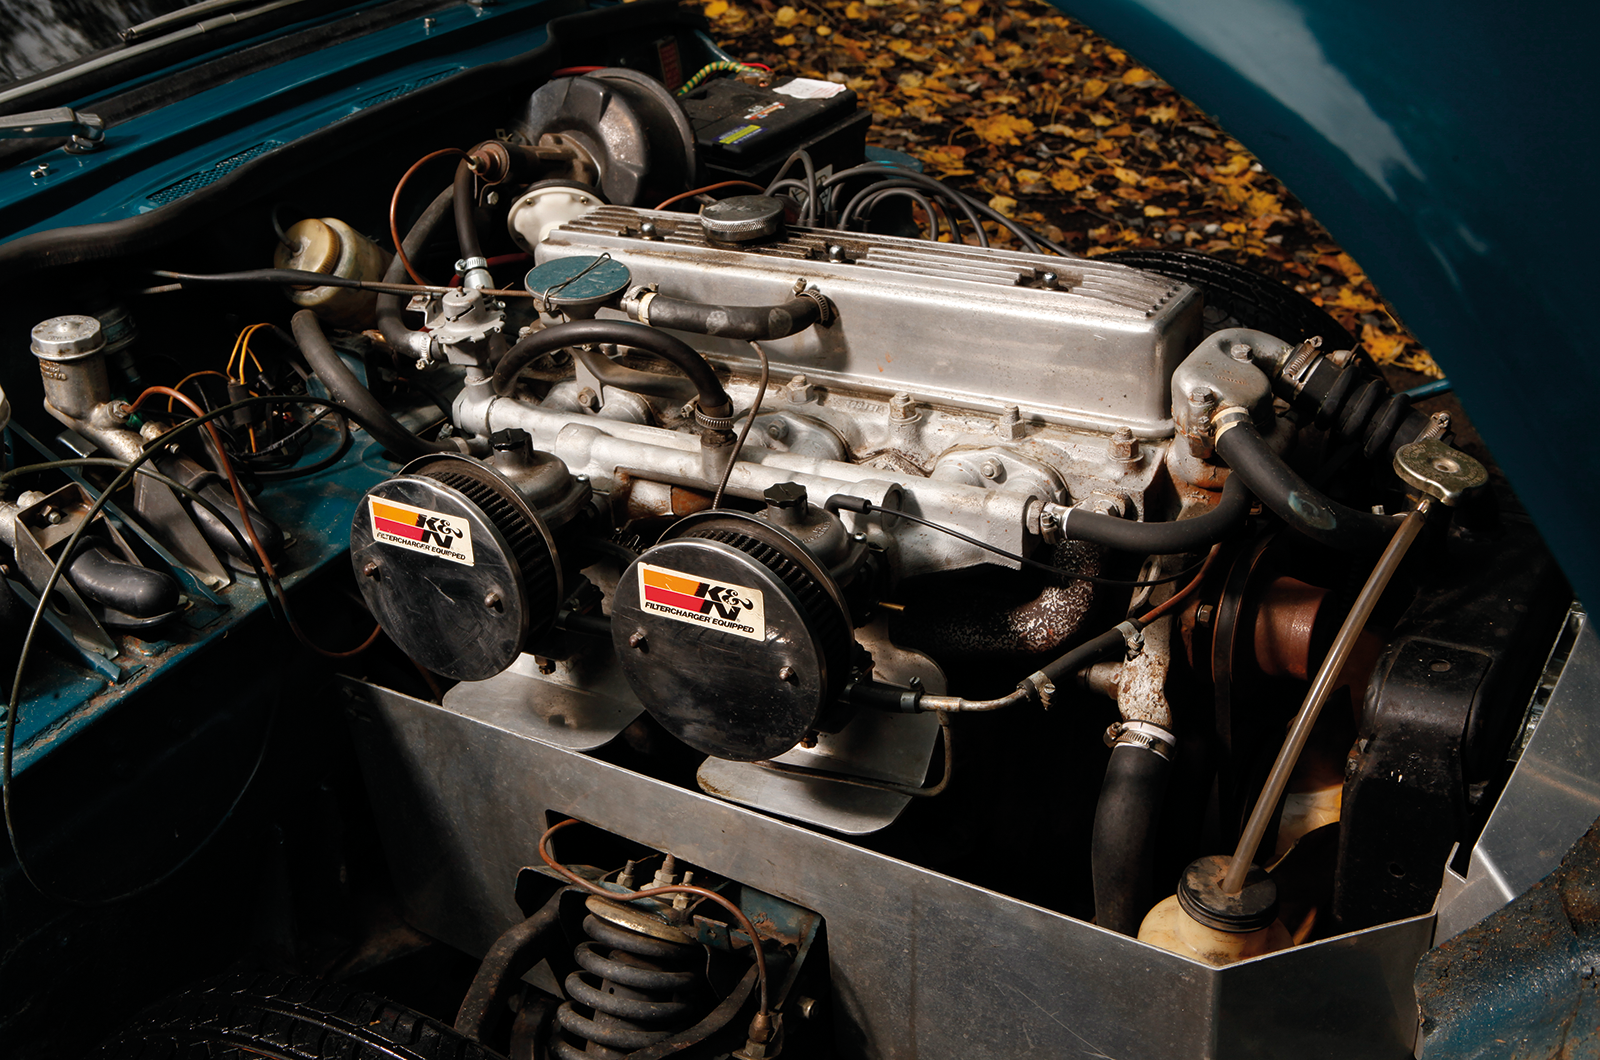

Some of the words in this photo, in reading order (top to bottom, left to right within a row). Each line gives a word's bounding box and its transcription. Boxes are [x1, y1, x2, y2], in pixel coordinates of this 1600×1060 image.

[431, 546, 466, 561] EQUIPPED
[644, 601, 711, 623] FILTERCHARGER
[711, 617, 755, 634] EQUIPPED
